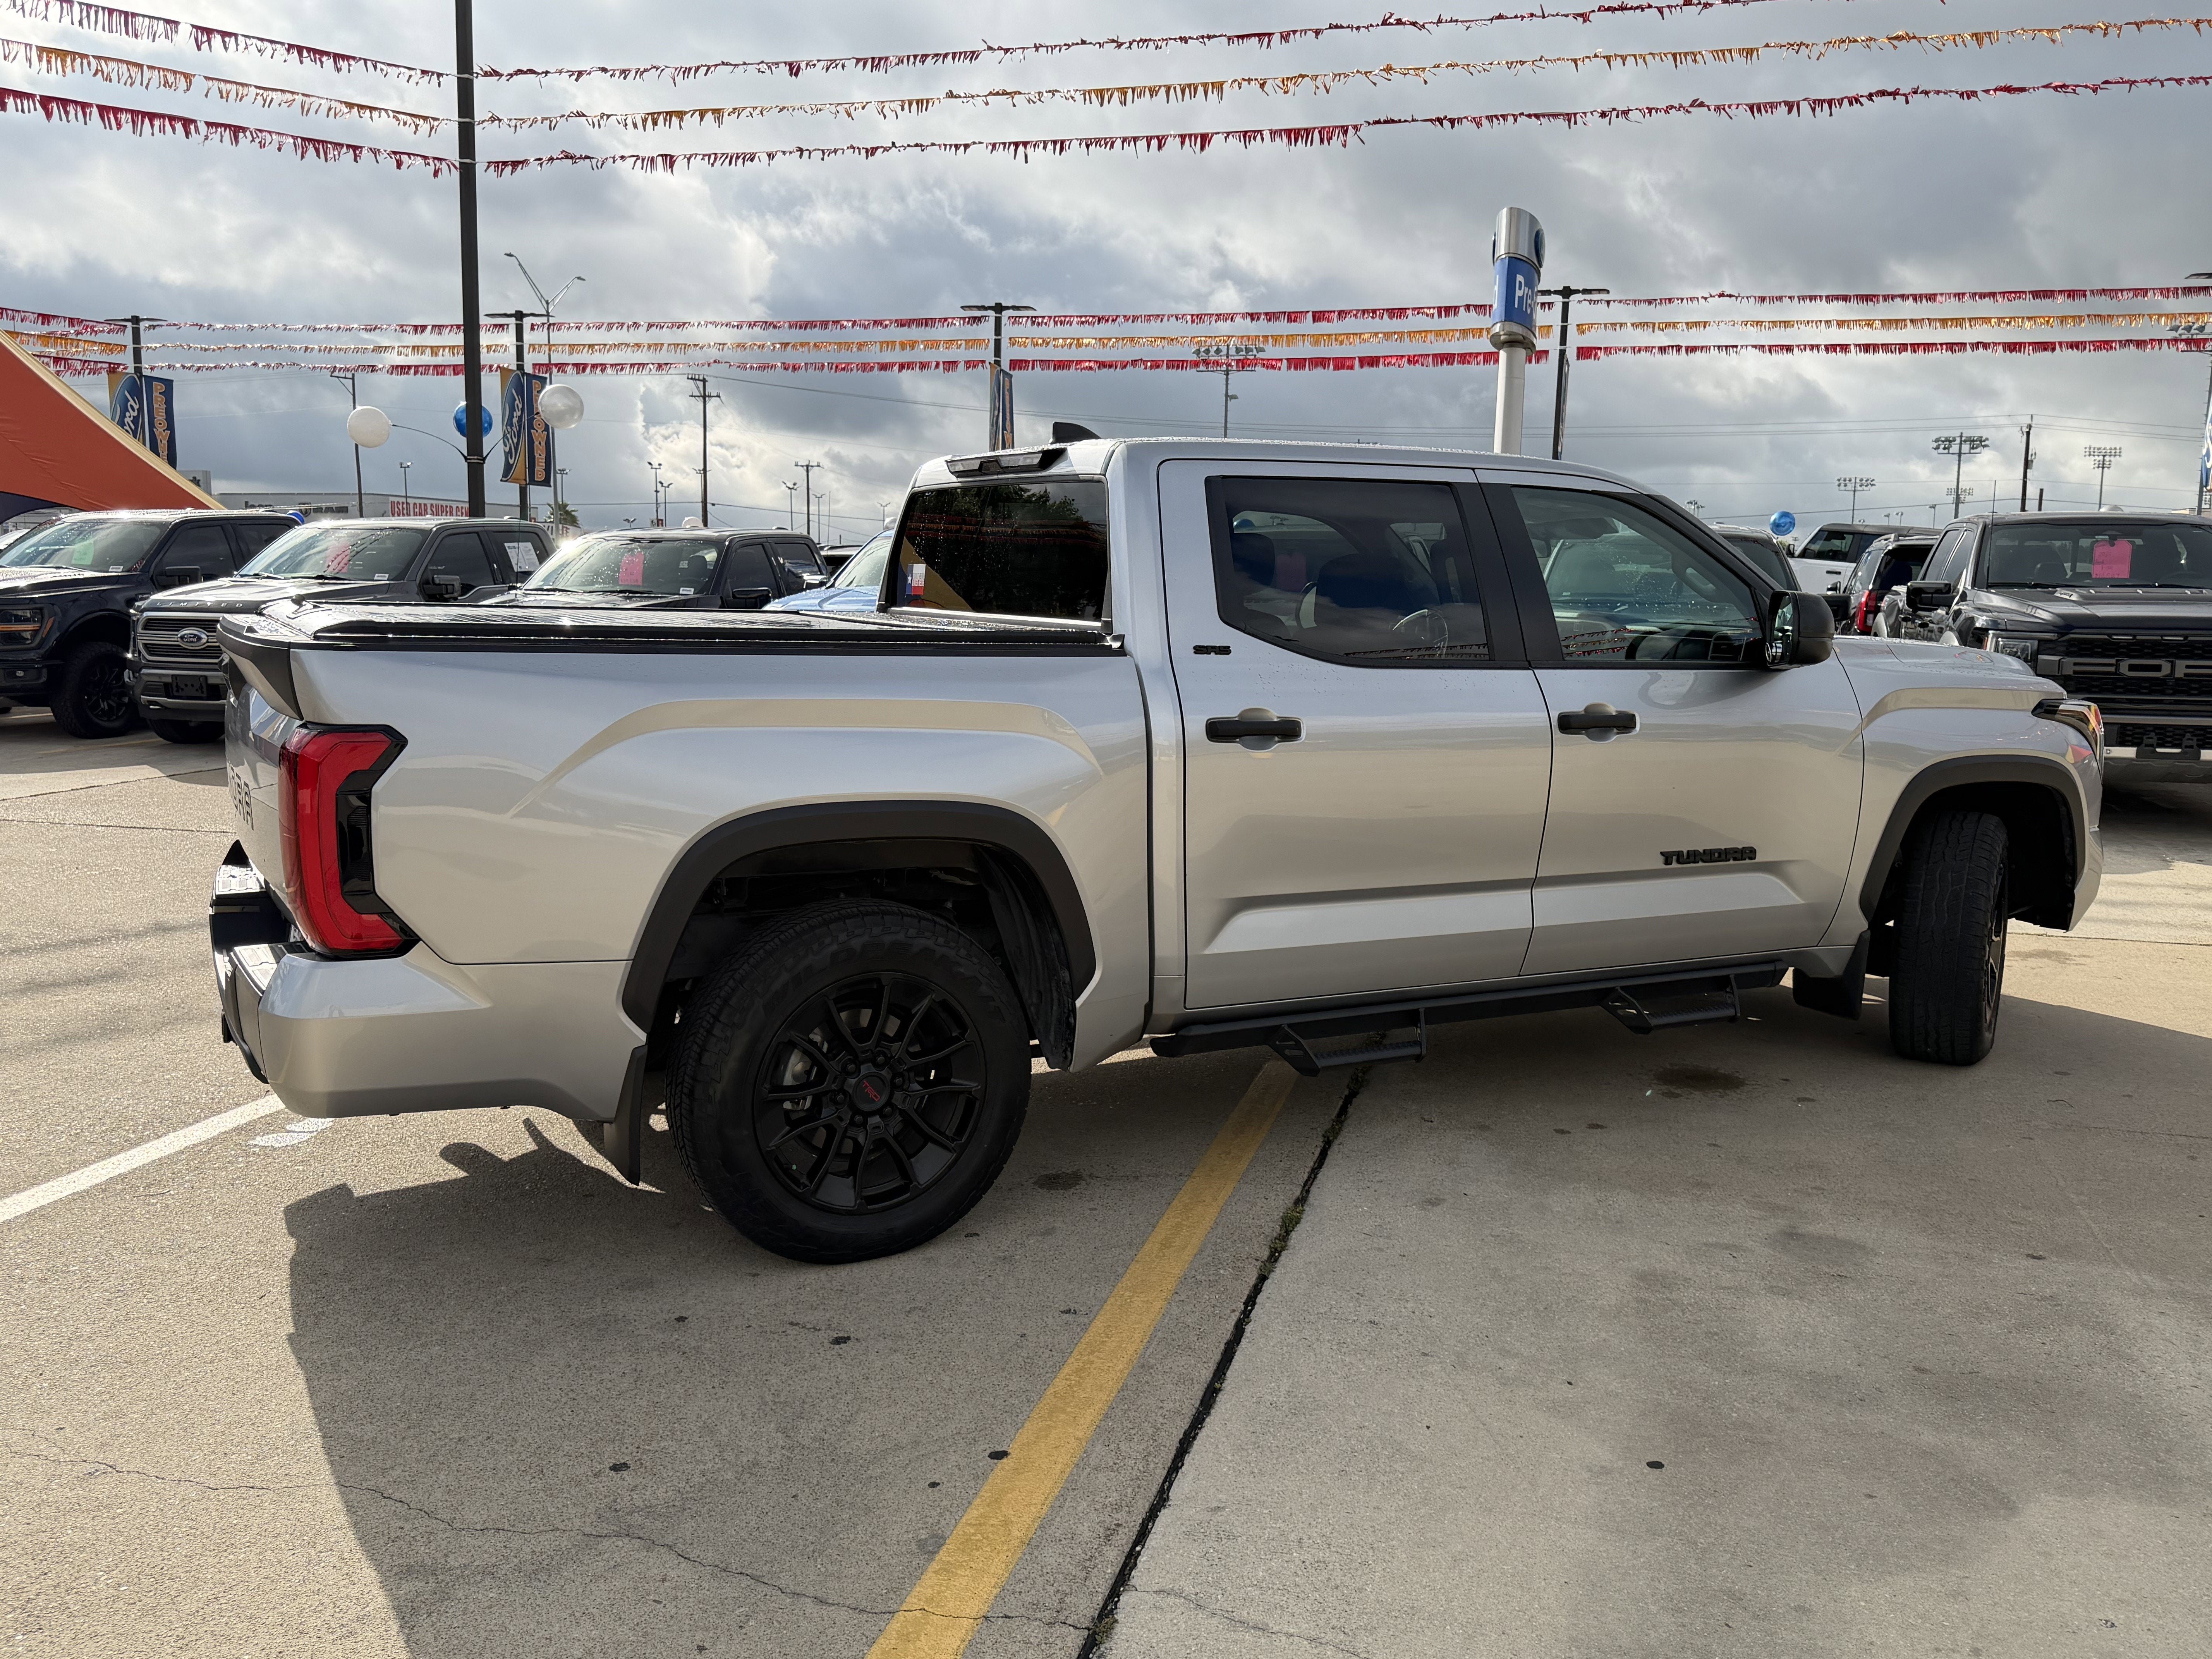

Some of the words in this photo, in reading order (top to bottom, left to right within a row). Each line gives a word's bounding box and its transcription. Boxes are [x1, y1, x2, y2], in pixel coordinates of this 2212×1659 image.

[153, 381, 171, 463] PREOWNE
[503, 388, 522, 464] Ford
[390, 500, 411, 517] USED
[413, 502, 428, 517] CAR
[430, 503, 453, 517] SUPER
[183, 634, 198, 642] Ford
[1193, 645, 1232, 655] SR5
[1660, 846, 1757, 866] TUNDRA
[862, 1080, 881, 1102] TRD
